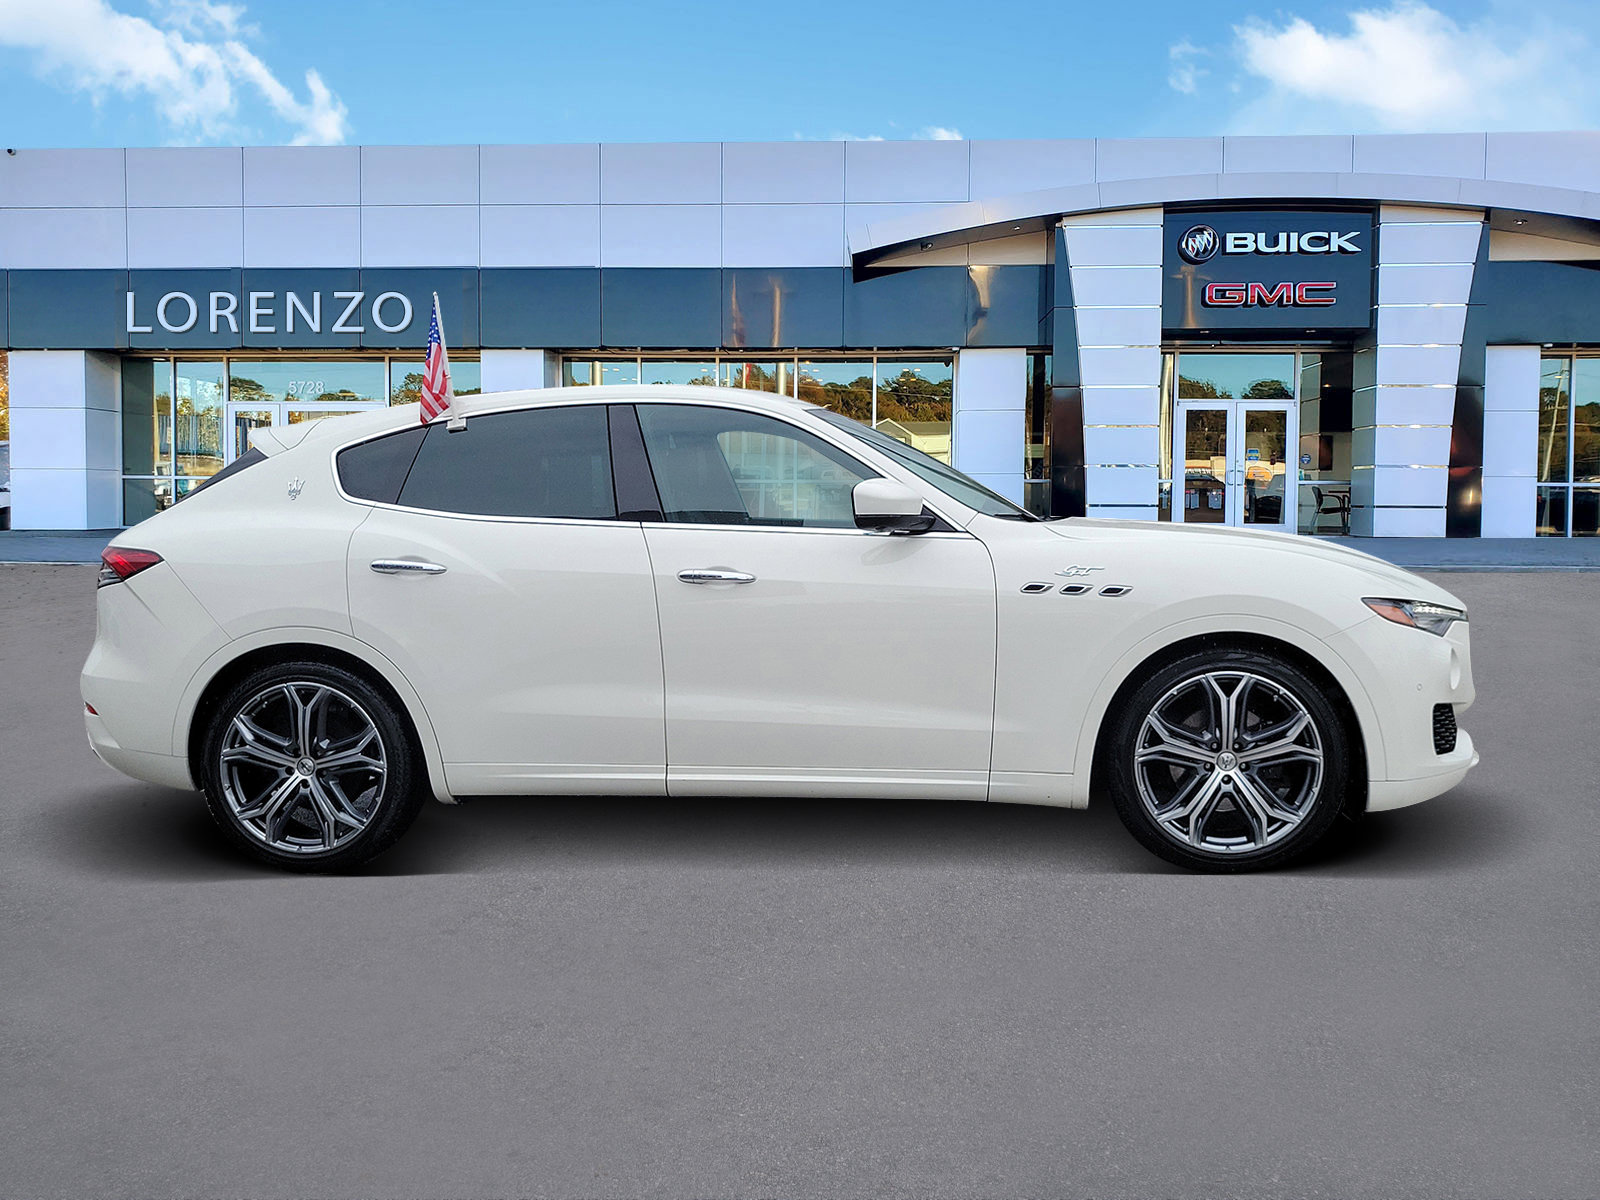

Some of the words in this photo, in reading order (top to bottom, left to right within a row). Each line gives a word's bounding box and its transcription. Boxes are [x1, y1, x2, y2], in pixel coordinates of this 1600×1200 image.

[1225, 231, 1361, 254] BUICK
[1205, 281, 1337, 306] GMC
[126, 291, 413, 334] LORENZO
[288, 380, 325, 394] 5728
